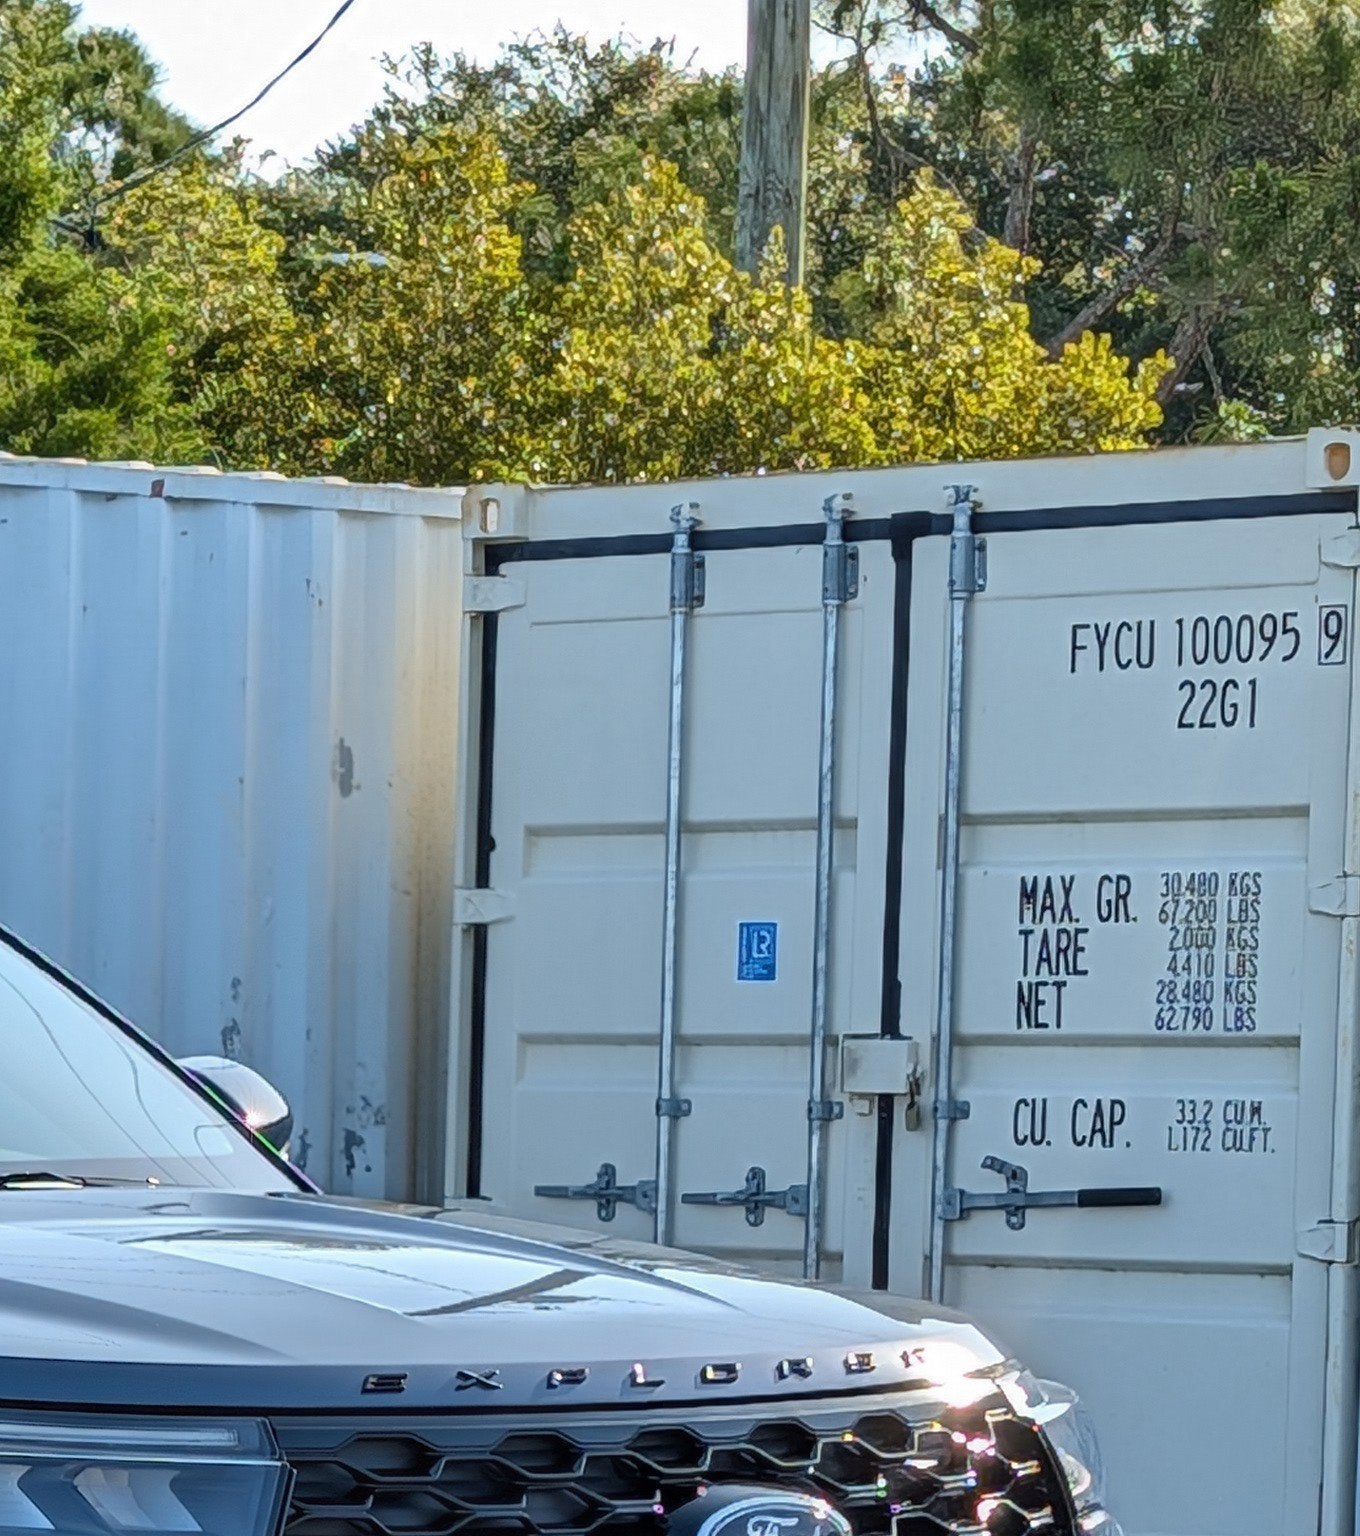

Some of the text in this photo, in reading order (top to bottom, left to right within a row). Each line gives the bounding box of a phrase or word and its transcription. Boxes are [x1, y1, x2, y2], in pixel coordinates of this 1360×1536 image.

[1070, 609, 1343, 674] FYCU 100095 9
[1176, 677, 1258, 729] 22G1
[1018, 874, 1139, 925] MAX. GR.
[1228, 871, 1263, 898] KGS
[1225, 898, 1262, 924] LBS
[1018, 927, 1090, 977] TARE
[1225, 926, 1261, 952] KGS
[1224, 952, 1259, 979] LBS
[1016, 980, 1068, 1030] NET
[1223, 979, 1258, 1006] KGS
[1222, 1005, 1257, 1033] LBS
[1013, 1098, 1132, 1149] CU. CAP.
[361, 1346, 926, 1395] EXPLORER
